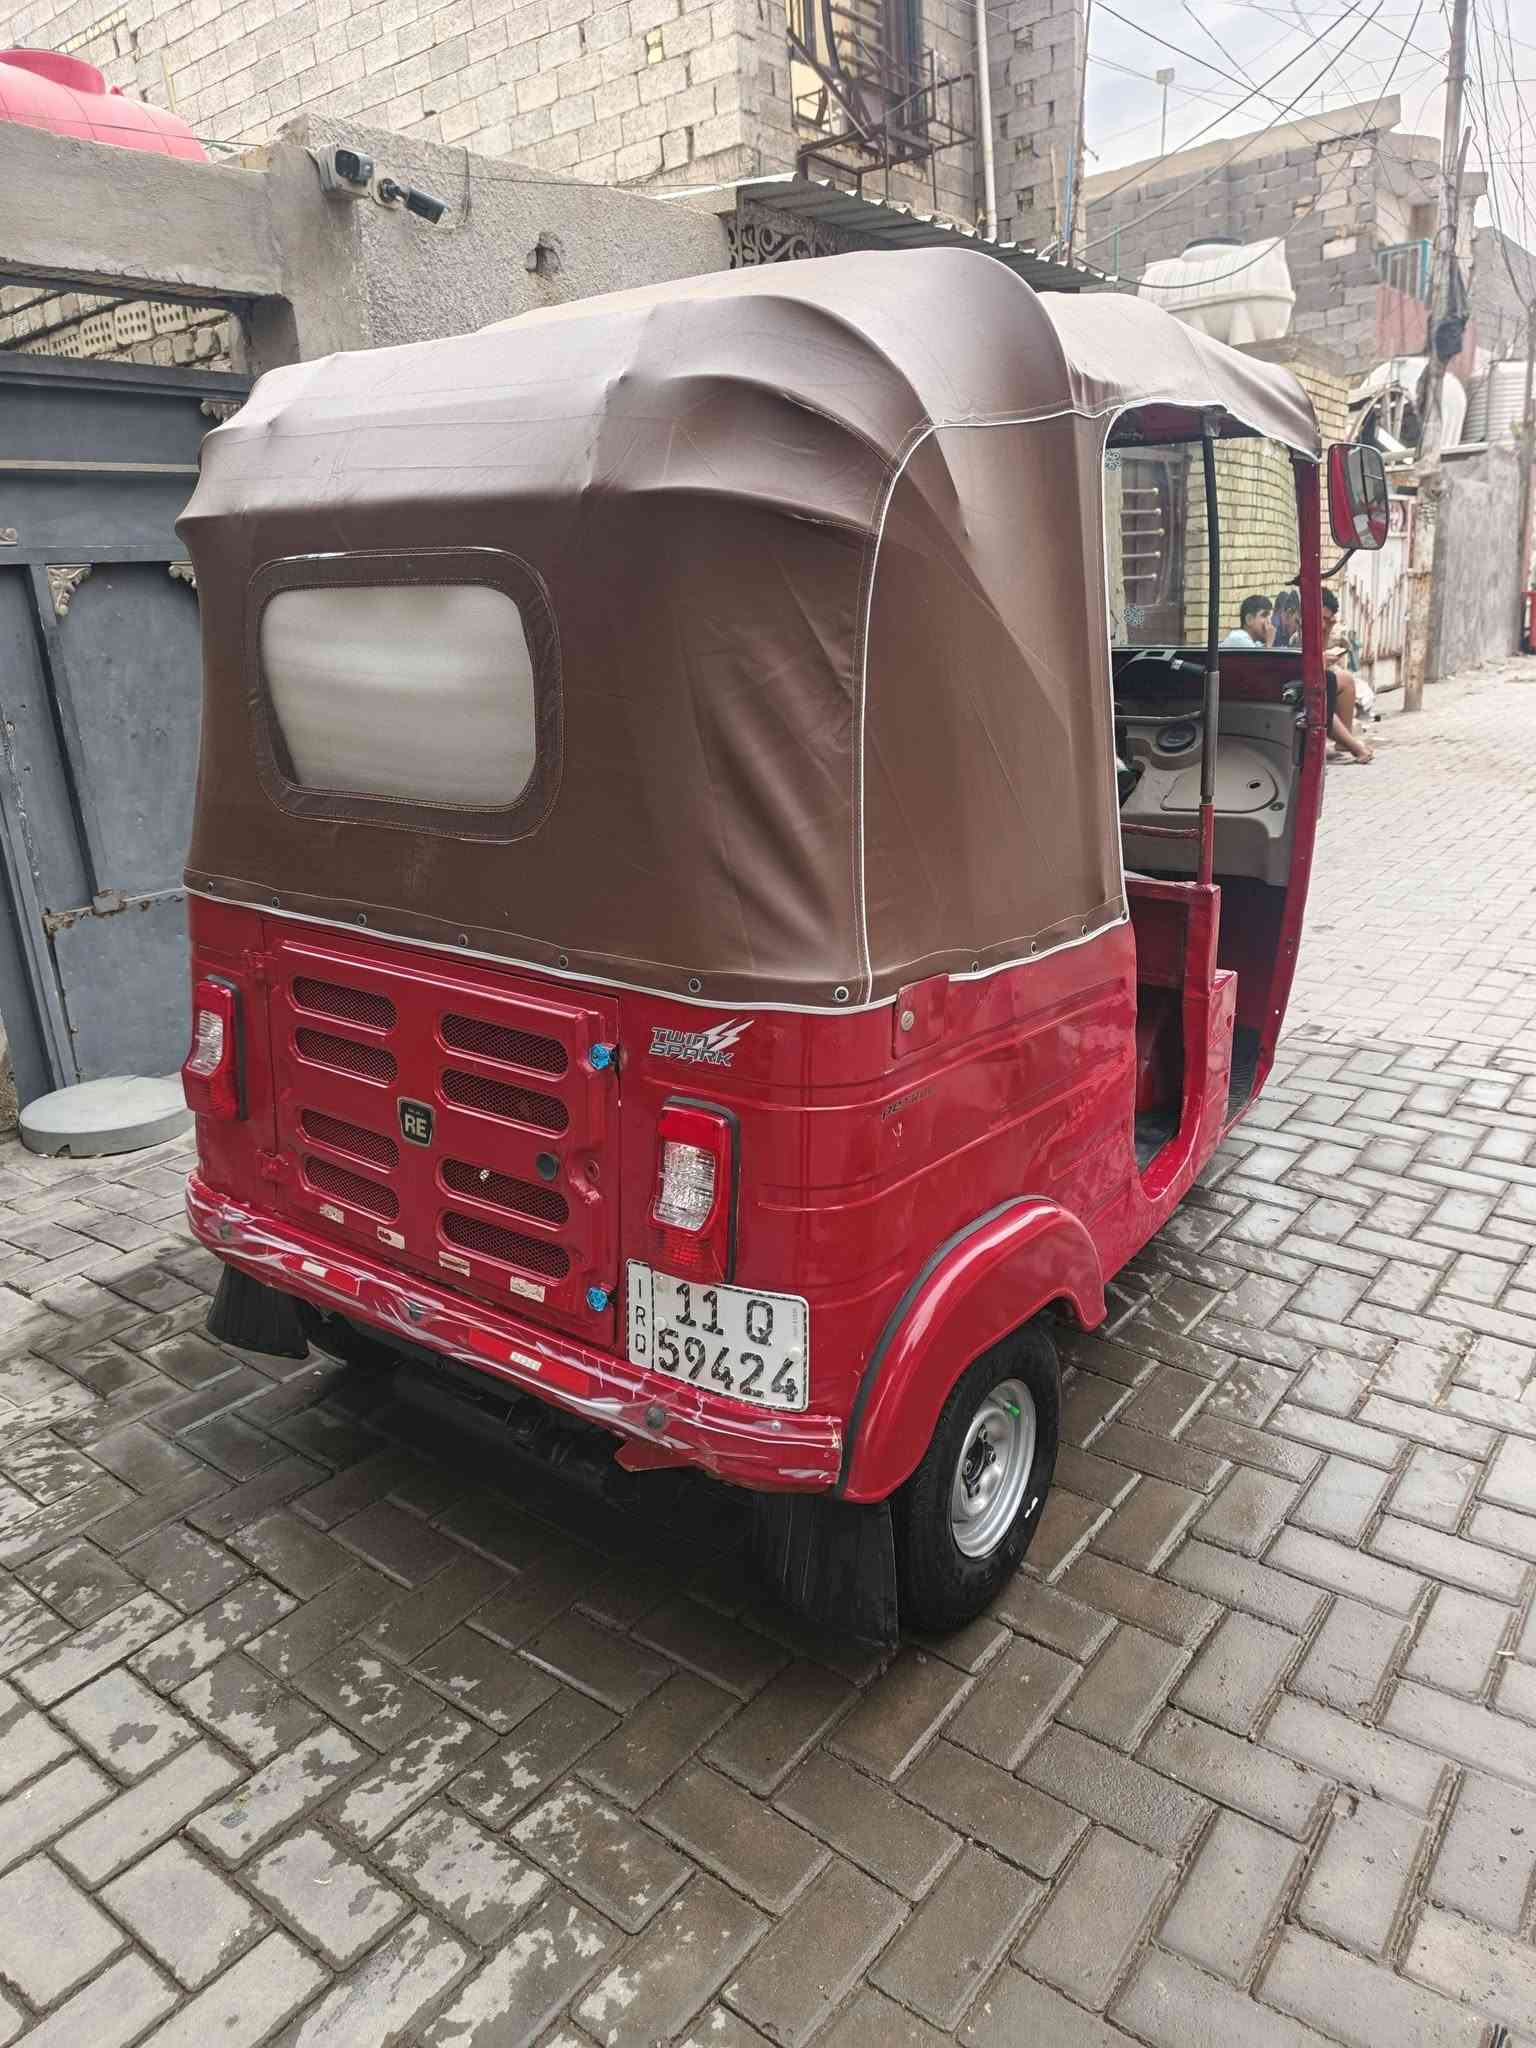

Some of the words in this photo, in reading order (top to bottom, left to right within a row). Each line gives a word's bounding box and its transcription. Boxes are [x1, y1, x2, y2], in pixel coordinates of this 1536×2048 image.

[649, 1042, 734, 1067] SPARK
[405, 1112, 427, 1138] RE
[676, 1283, 724, 1336] 11
[746, 1299, 773, 1346] Q
[658, 1327, 798, 1402] 59424
